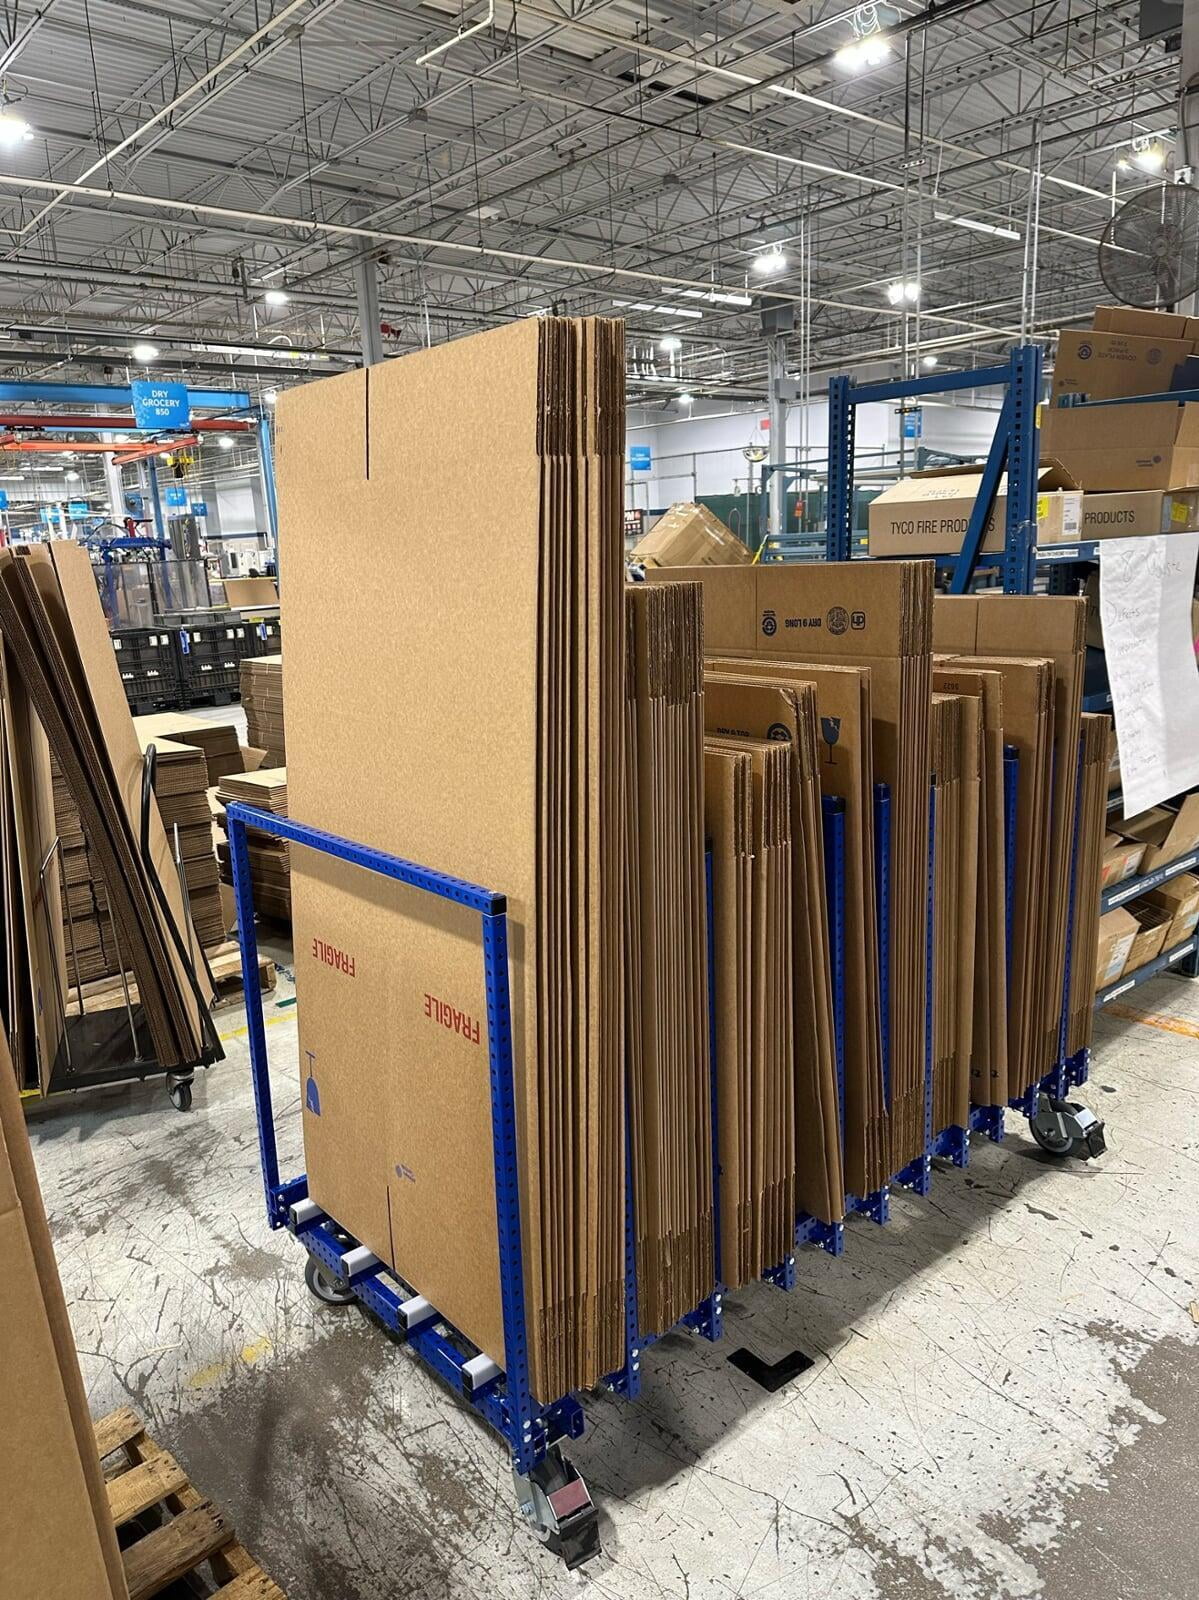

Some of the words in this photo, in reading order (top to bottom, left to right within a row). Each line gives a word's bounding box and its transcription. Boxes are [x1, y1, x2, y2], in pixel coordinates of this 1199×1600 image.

[151, 390, 169, 398] DRY
[142, 399, 180, 407] GROCERY
[1084, 510, 1135, 524] PRODUCTS
[890, 521, 915, 535] TYCO
[917, 520, 938, 534] FIRE
[784, 619, 802, 628] LONG
[808, 618, 822, 627] DRY
[312, 938, 356, 977] FRAGILE
[424, 994, 480, 1045] FRAGILE
